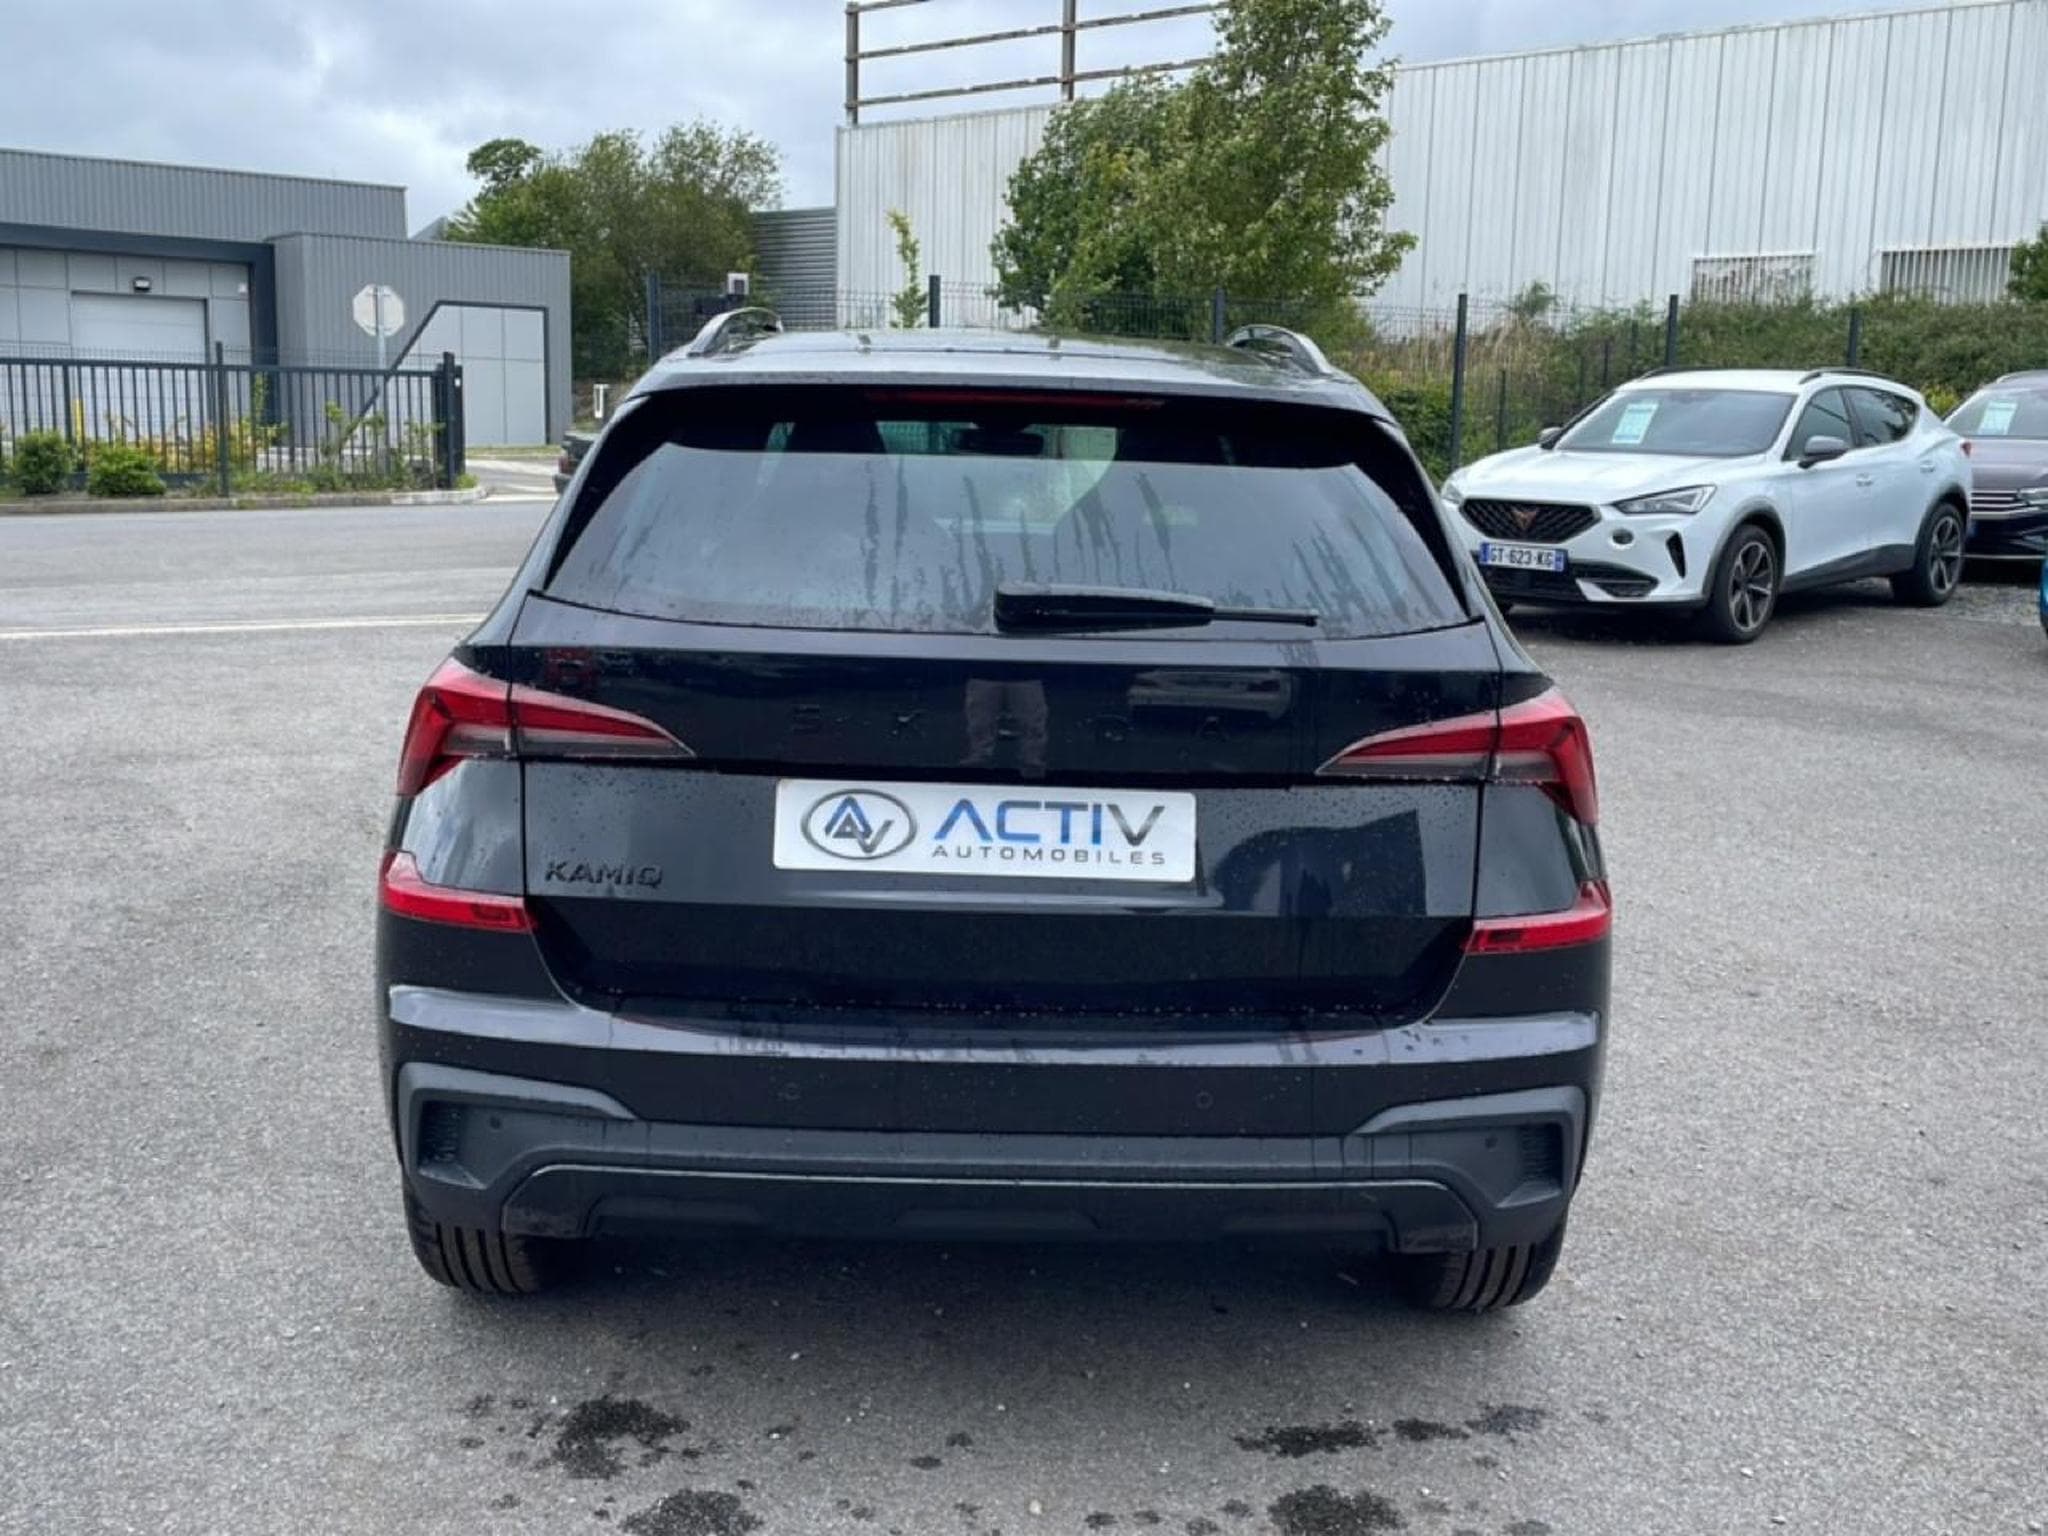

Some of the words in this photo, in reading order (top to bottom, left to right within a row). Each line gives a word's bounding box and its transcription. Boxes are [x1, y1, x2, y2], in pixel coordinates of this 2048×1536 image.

[934, 798, 1165, 847] ACTIV
[932, 845, 1166, 865] AUTOMOBILES
[545, 860, 663, 889] KAMIQ
